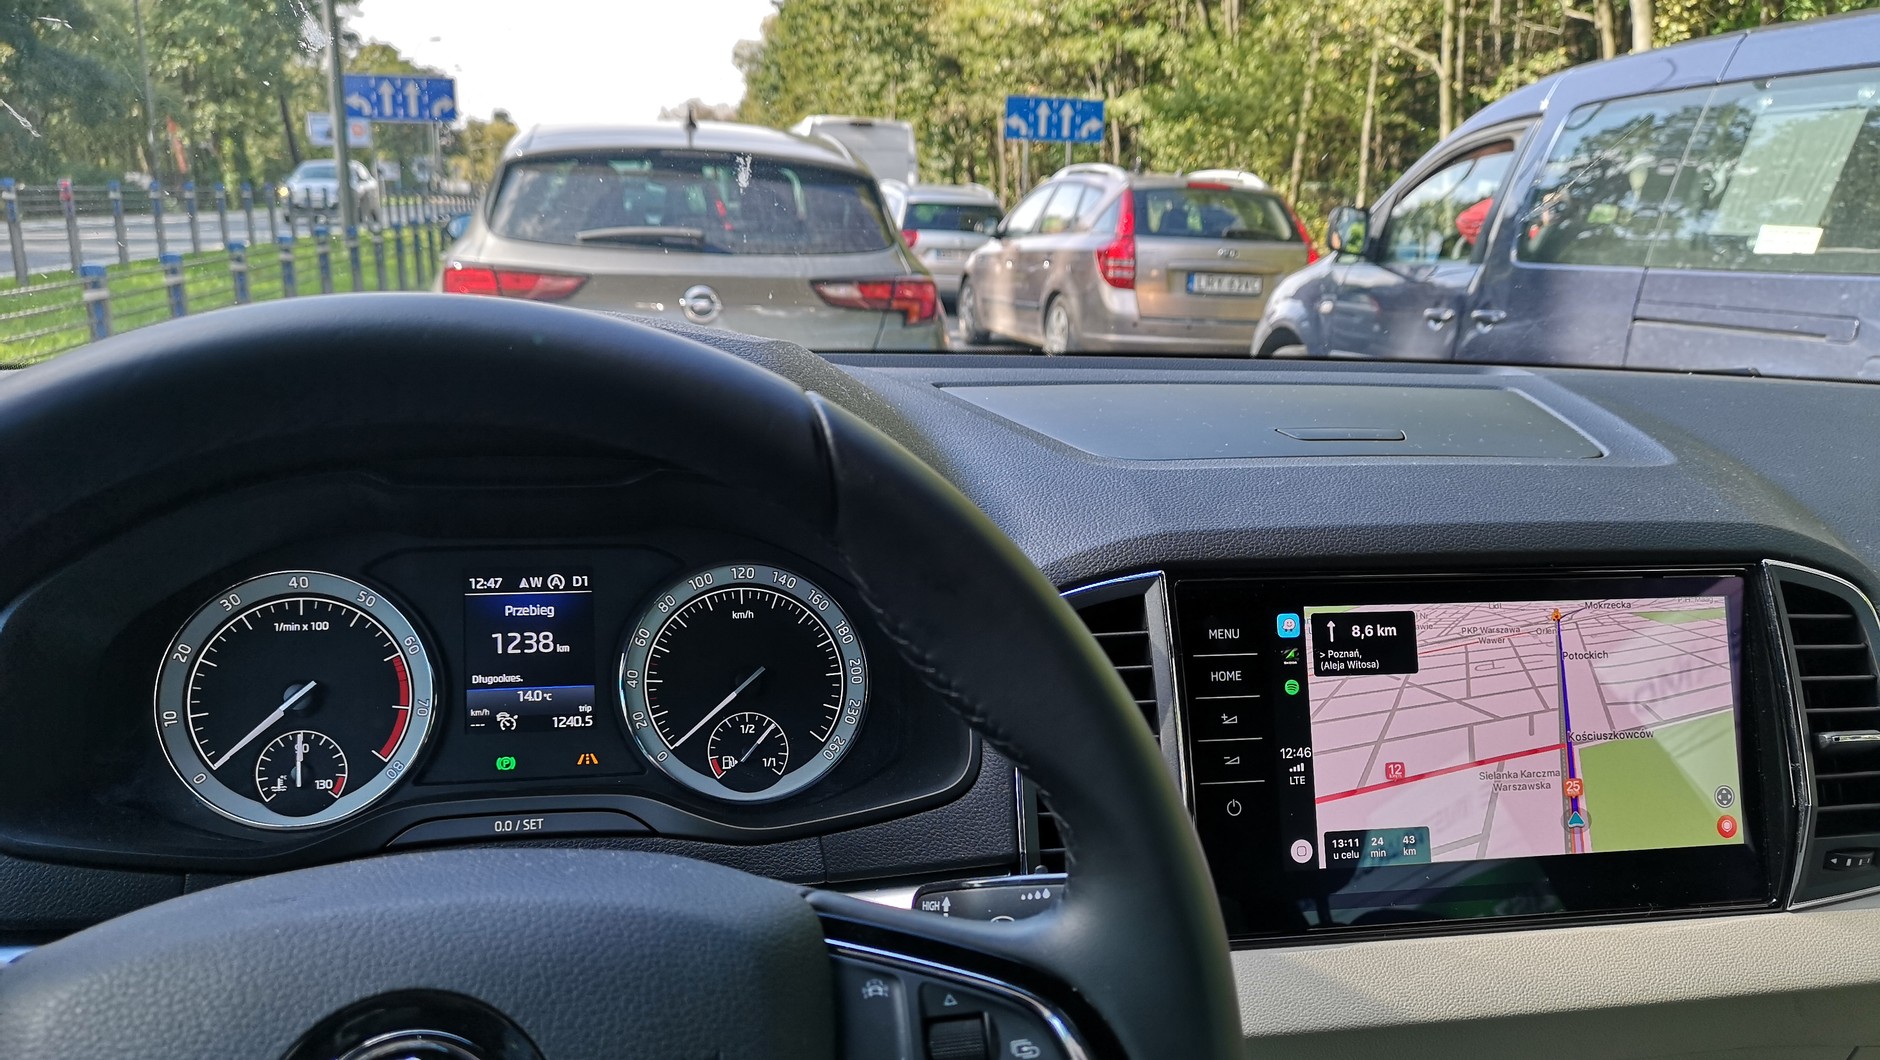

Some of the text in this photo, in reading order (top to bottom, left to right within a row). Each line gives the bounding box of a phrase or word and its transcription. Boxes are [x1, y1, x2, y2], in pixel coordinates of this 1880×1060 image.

[731, 567, 755, 579] 120
[288, 576, 309, 589] 40
[469, 577, 502, 589] 12:47
[573, 575, 588, 587] D1
[688, 573, 714, 591] 100
[772, 571, 797, 589] 140
[219, 593, 241, 612] 30
[357, 590, 377, 607] 50
[658, 595, 676, 613] 80
[807, 589, 830, 611] 160
[504, 604, 555, 618] Przebieg
[1488, 602, 1502, 610] Lidl
[1584, 601, 1632, 610] Mokrzecka
[732, 610, 754, 620] km/h
[274, 621, 330, 632] 1/min x 100
[834, 620, 854, 645] 180
[1351, 624, 1397, 638] 8,6 km
[1461, 626, 1521, 635] PKP Warszawa
[635, 628, 650, 647] 60
[1208, 628, 1240, 640] MENU
[403, 636, 420, 655] 60
[491, 631, 570, 654] 1238 km
[1478, 636, 1506, 645] Wawer
[173, 643, 192, 663] 20
[1327, 648, 1362, 660] Poznań,
[1562, 650, 1609, 661] Potockich
[849, 658, 863, 684] 200
[1320, 659, 1380, 671] (Aleja Witosa)
[627, 669, 639, 688] 40
[1210, 671, 1242, 682] HOME
[417, 699, 429, 717] 70
[470, 708, 490, 718] km/h
[578, 704, 592, 713] trip
[844, 699, 861, 725] 230
[163, 711, 178, 727] 10
[552, 716, 593, 728] 1240.5
[632, 711, 648, 730] 20
[740, 724, 755, 734] 1/2
[1567, 729, 1655, 742] Kościuszkowców
[822, 735, 846, 761] 260
[1280, 747, 1312, 759] 12:46
[657, 751, 668, 762] 0
[762, 758, 776, 768] 1/1
[386, 761, 404, 779] 80
[1388, 764, 1402, 775] 12
[1479, 769, 1561, 781] Sielanka Karczma
[193, 773, 207, 785] 0
[315, 779, 333, 789] 130
[1289, 776, 1306, 785] LTE
[1493, 781, 1551, 792] Warszawska
[1565, 780, 1581, 791] 25
[494, 820, 512, 832] 0.0
[523, 818, 544, 831] SET
[1332, 838, 1359, 848] 13:11
[1371, 837, 1384, 846] 24
[1402, 835, 1415, 845] 43
[1341, 850, 1360, 859] celu
[1370, 849, 1387, 858] min
[1403, 847, 1417, 856] km
[922, 901, 940, 911] HIGH
